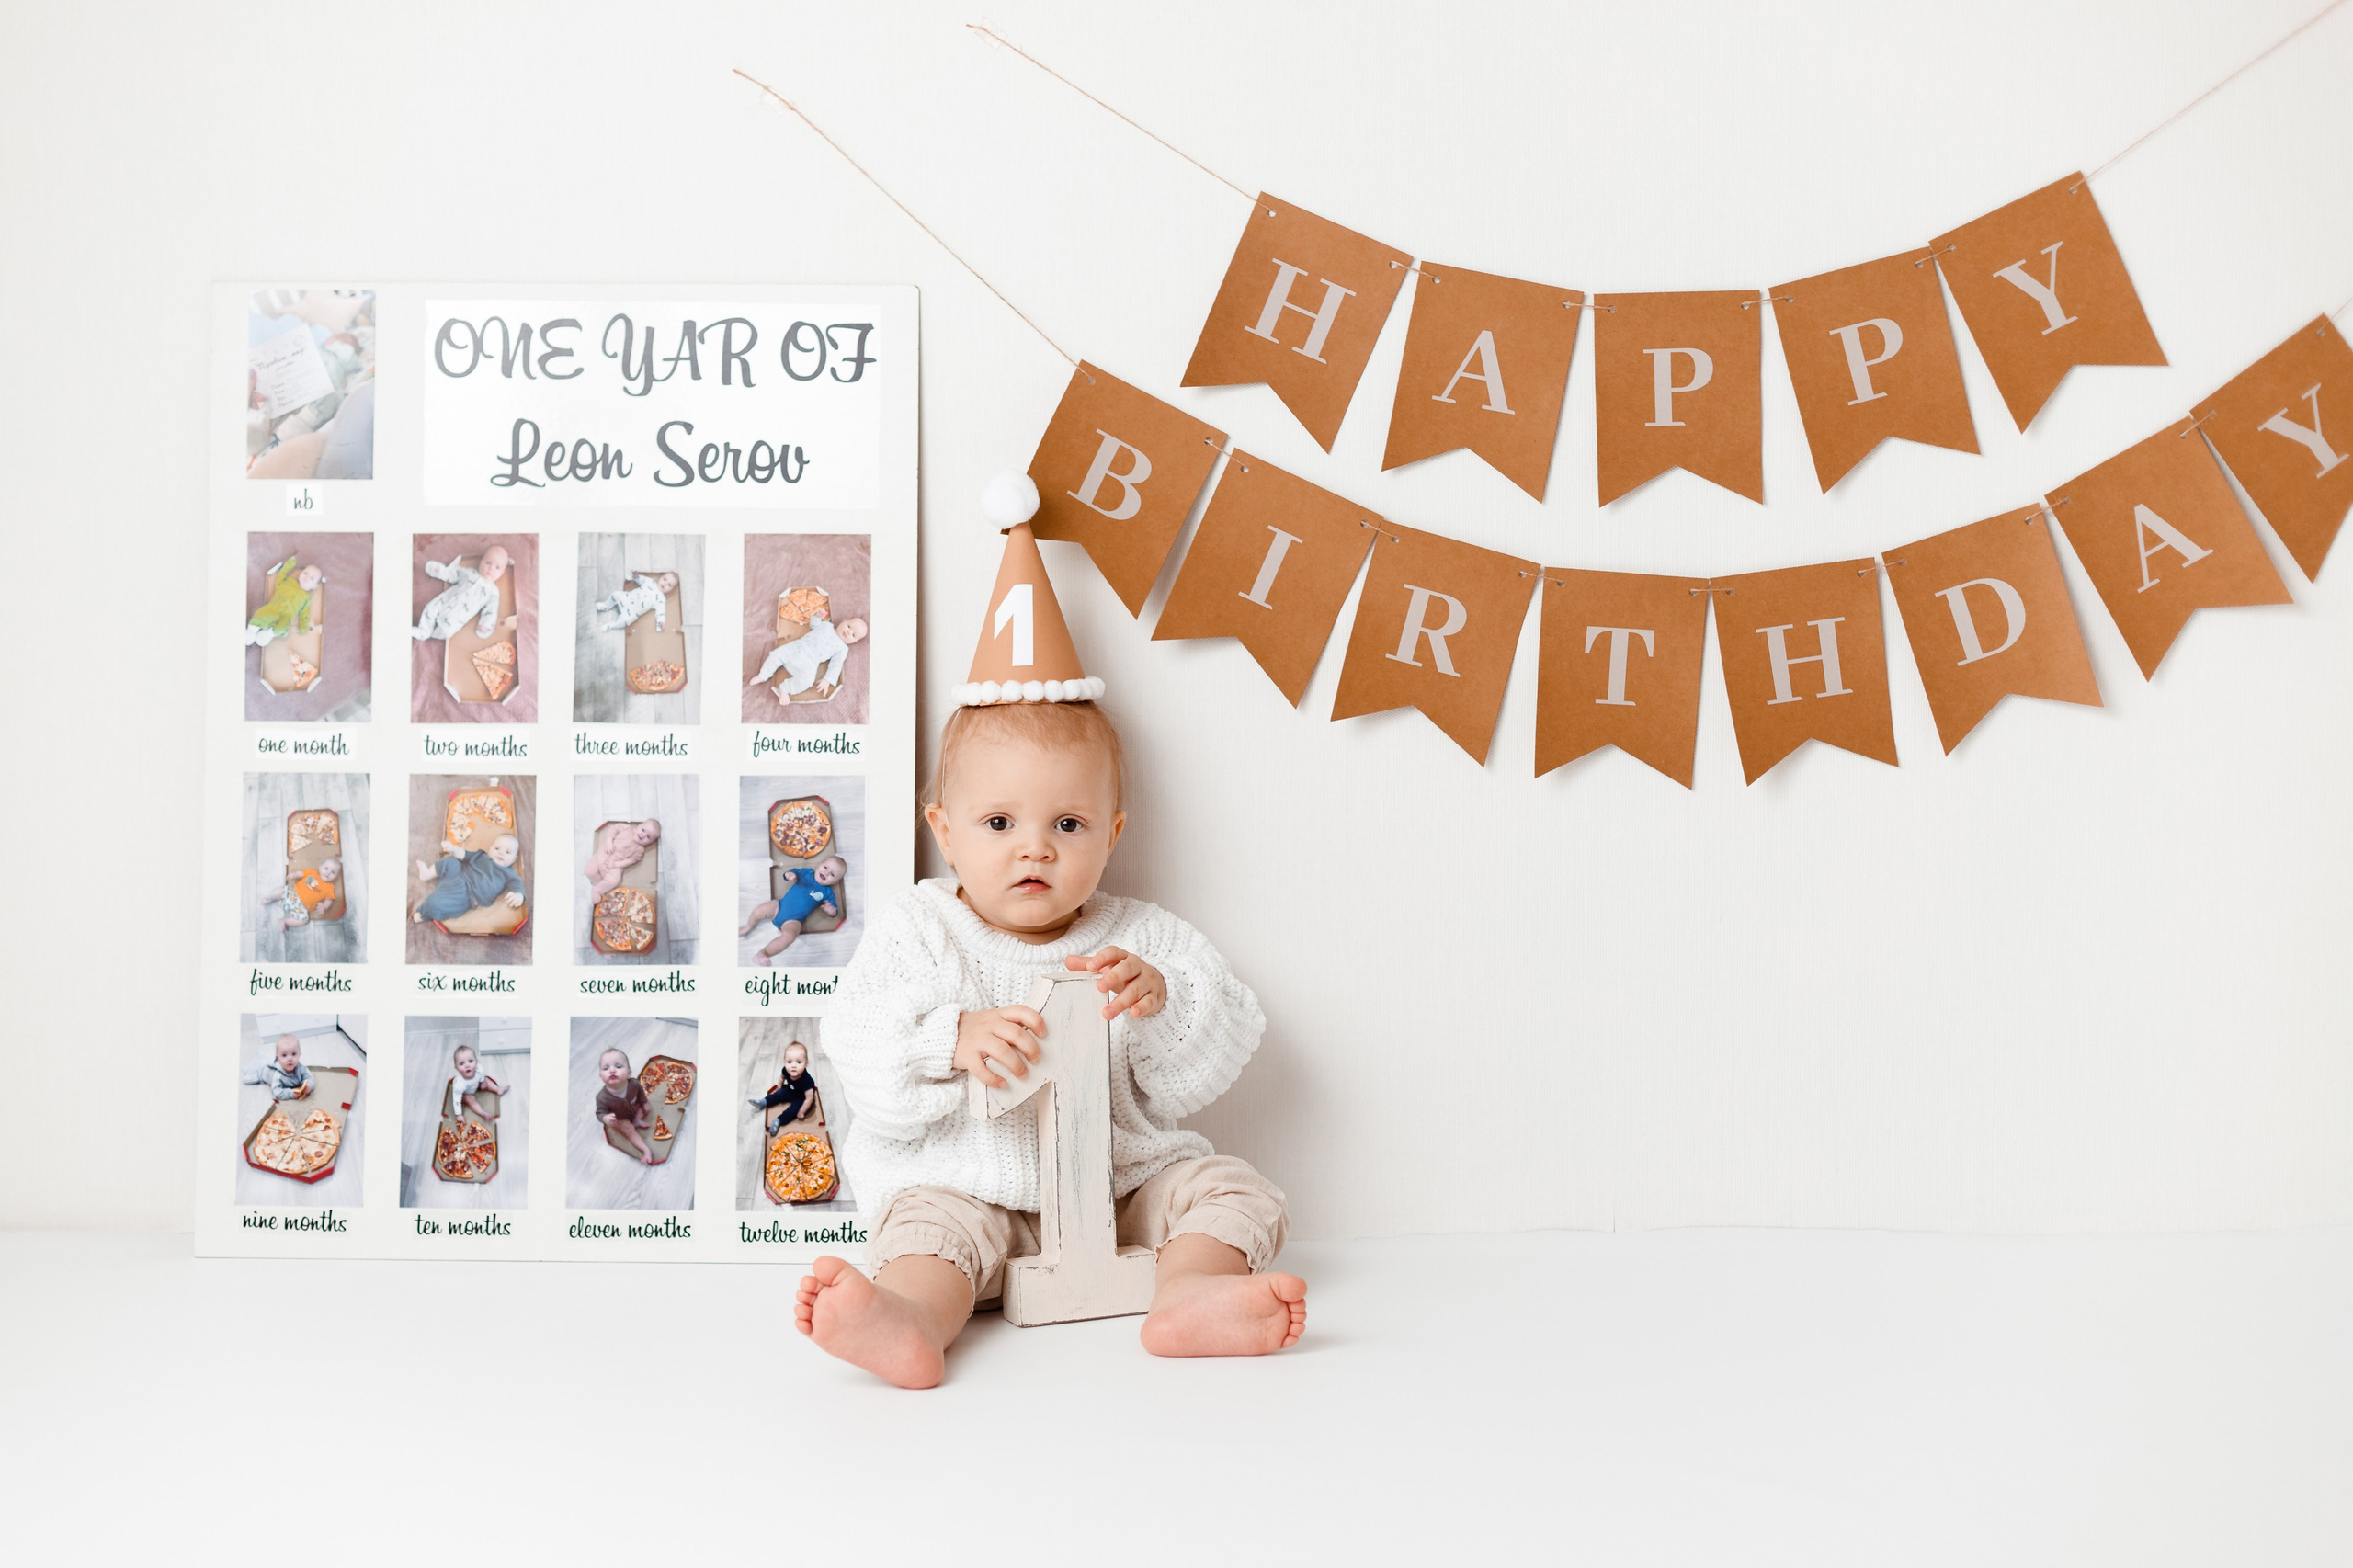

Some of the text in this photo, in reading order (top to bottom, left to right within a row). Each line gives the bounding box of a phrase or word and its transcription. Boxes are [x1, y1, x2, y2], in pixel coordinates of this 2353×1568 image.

[1244, 241, 2078, 427] HAPPY
[435, 313, 877, 396] ONE YAR OF
[491, 418, 810, 487] Leon Serov
[294, 489, 313, 509] nb
[1067, 383, 2349, 706] BIRTHDAY
[994, 584, 1034, 666] 1
[258, 733, 349, 756] one month
[425, 735, 528, 756] two months
[574, 732, 688, 756] three months
[753, 731, 860, 758] four months
[250, 968, 351, 995] five months
[419, 971, 515, 992] six months
[580, 971, 695, 994] seven months
[745, 971, 791, 1006] eight
[243, 1210, 347, 1232] nine months
[415, 1214, 510, 1235] ten months
[569, 1215, 691, 1239] eleven months
[739, 1220, 868, 1244] twelve months
